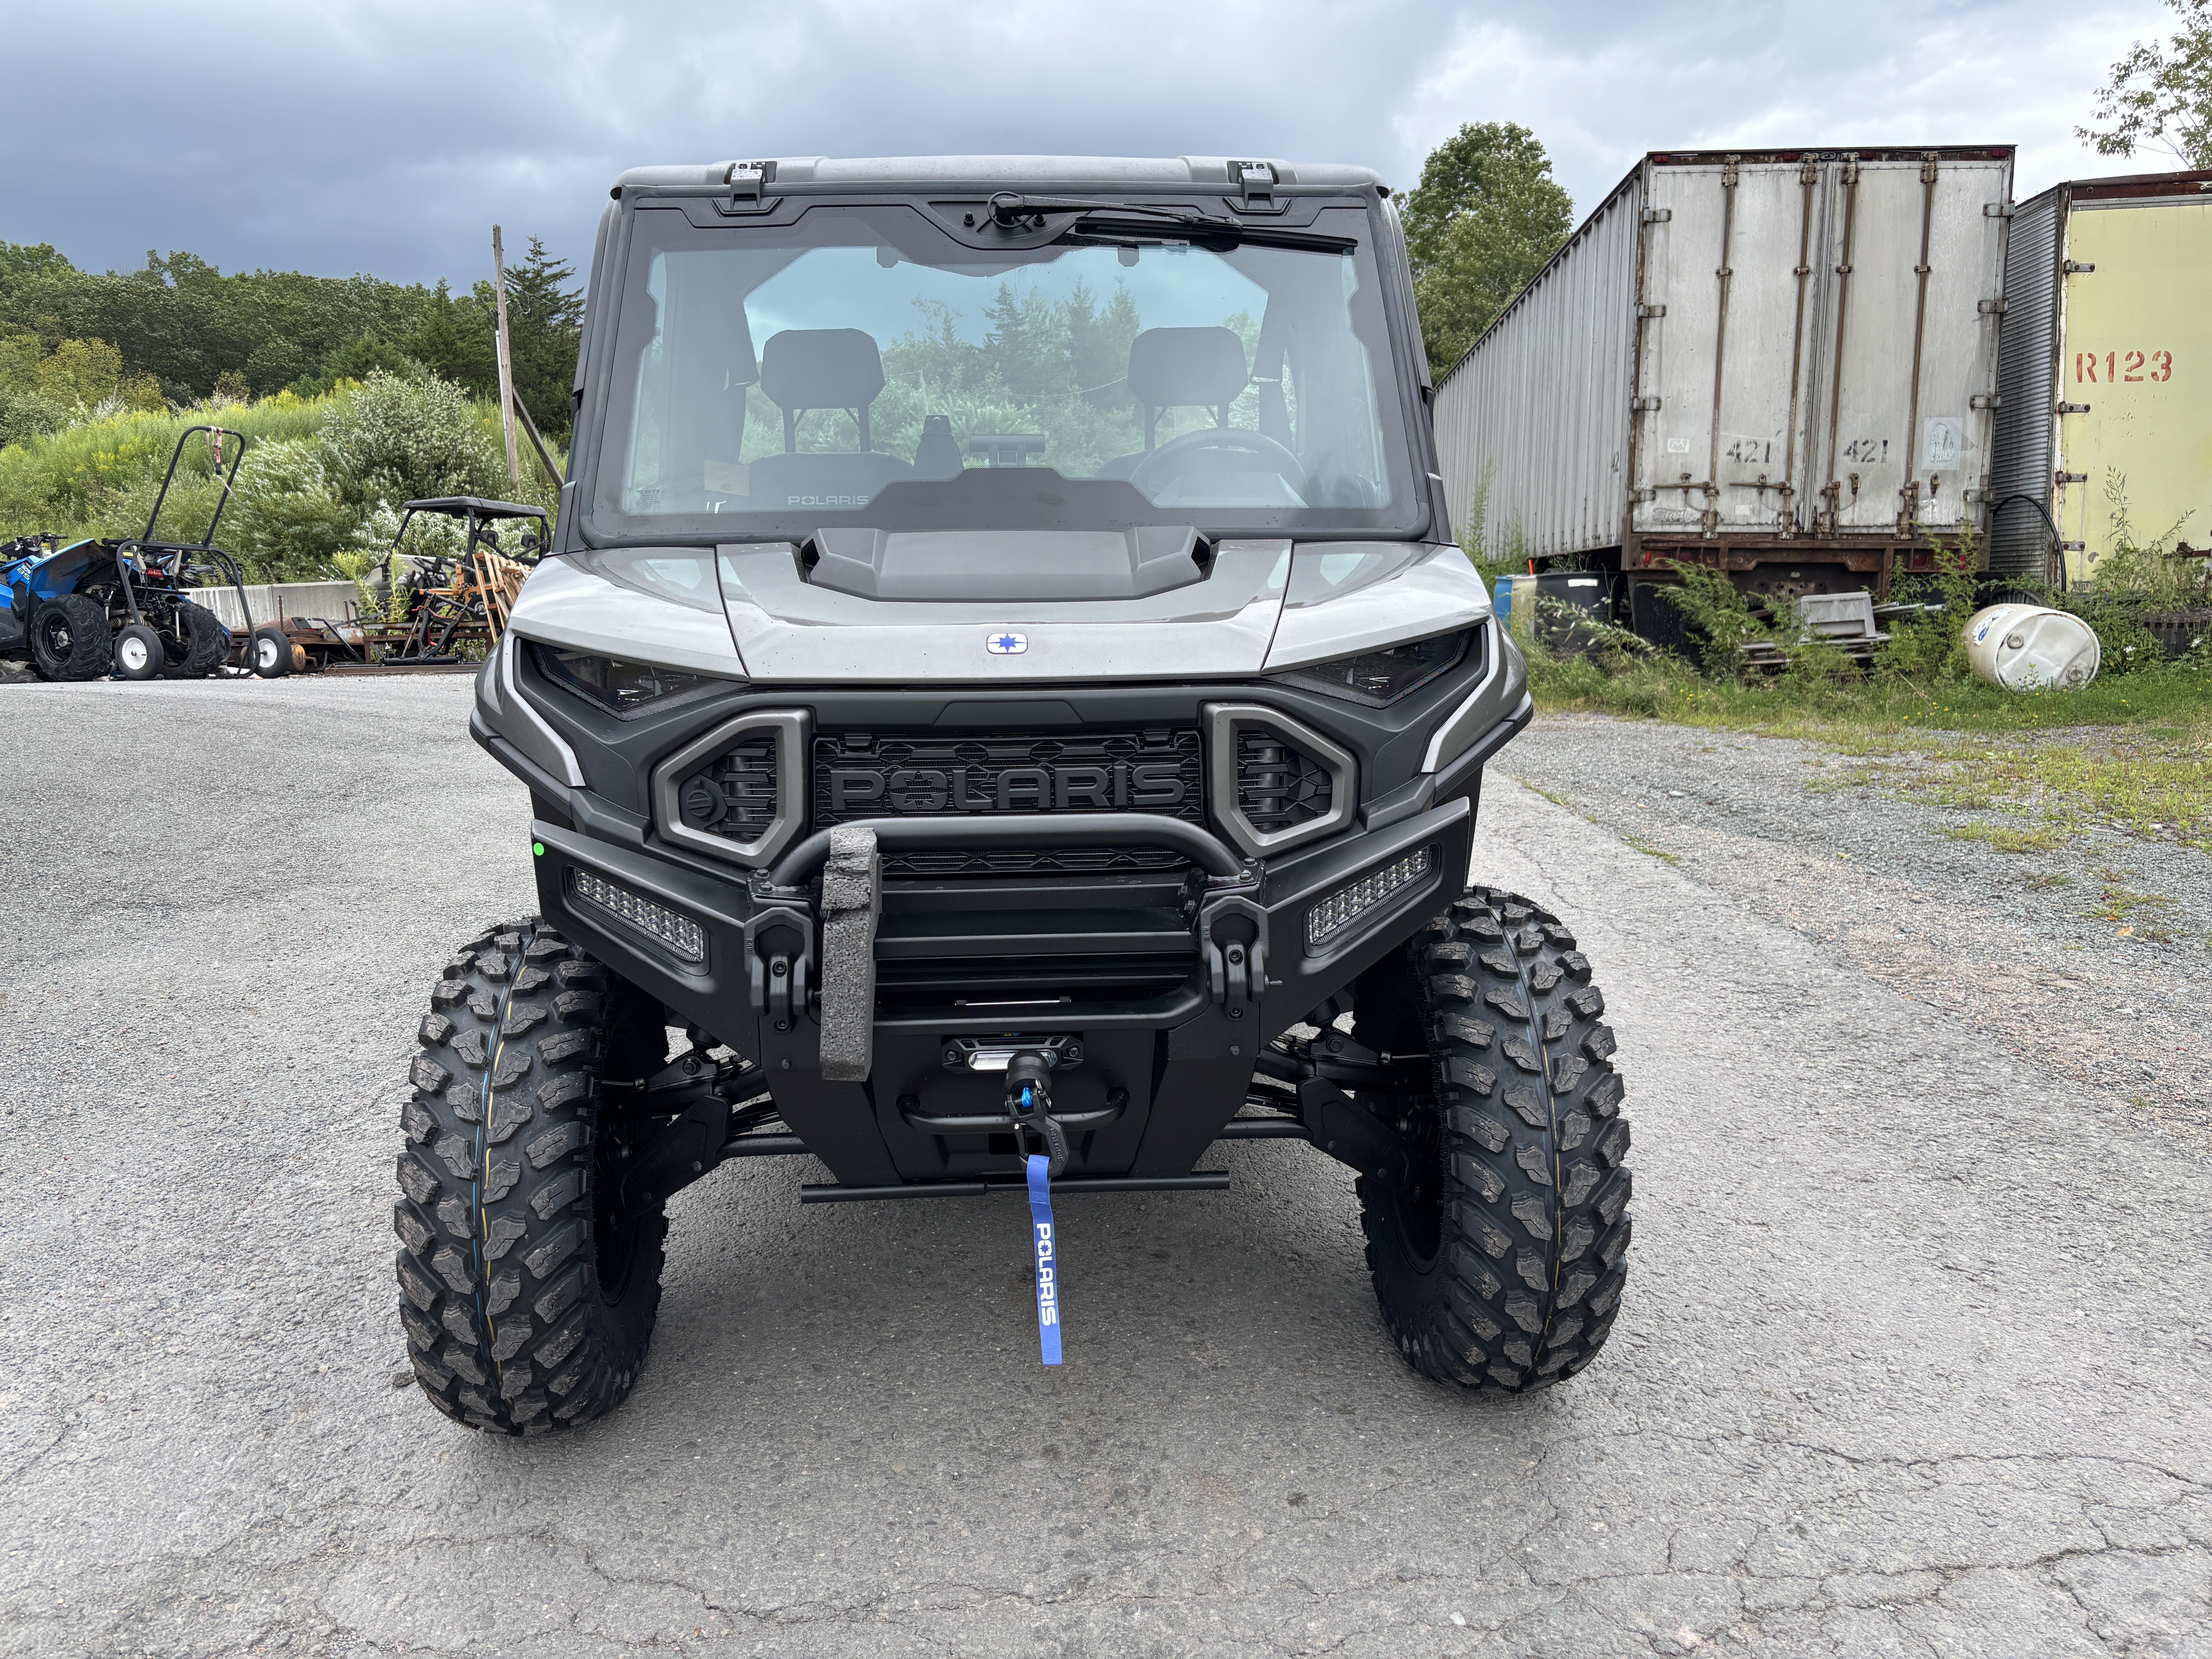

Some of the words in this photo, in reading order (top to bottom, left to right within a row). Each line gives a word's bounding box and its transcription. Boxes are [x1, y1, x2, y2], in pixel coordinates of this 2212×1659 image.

[2076, 350, 2172, 383] R123
[1726, 440, 1770, 463] 421
[1843, 440, 1888, 463] 421
[788, 495, 869, 505] POLARIS
[830, 763, 1186, 810] POLARIS
[1036, 1223, 1056, 1326] POLARIS
